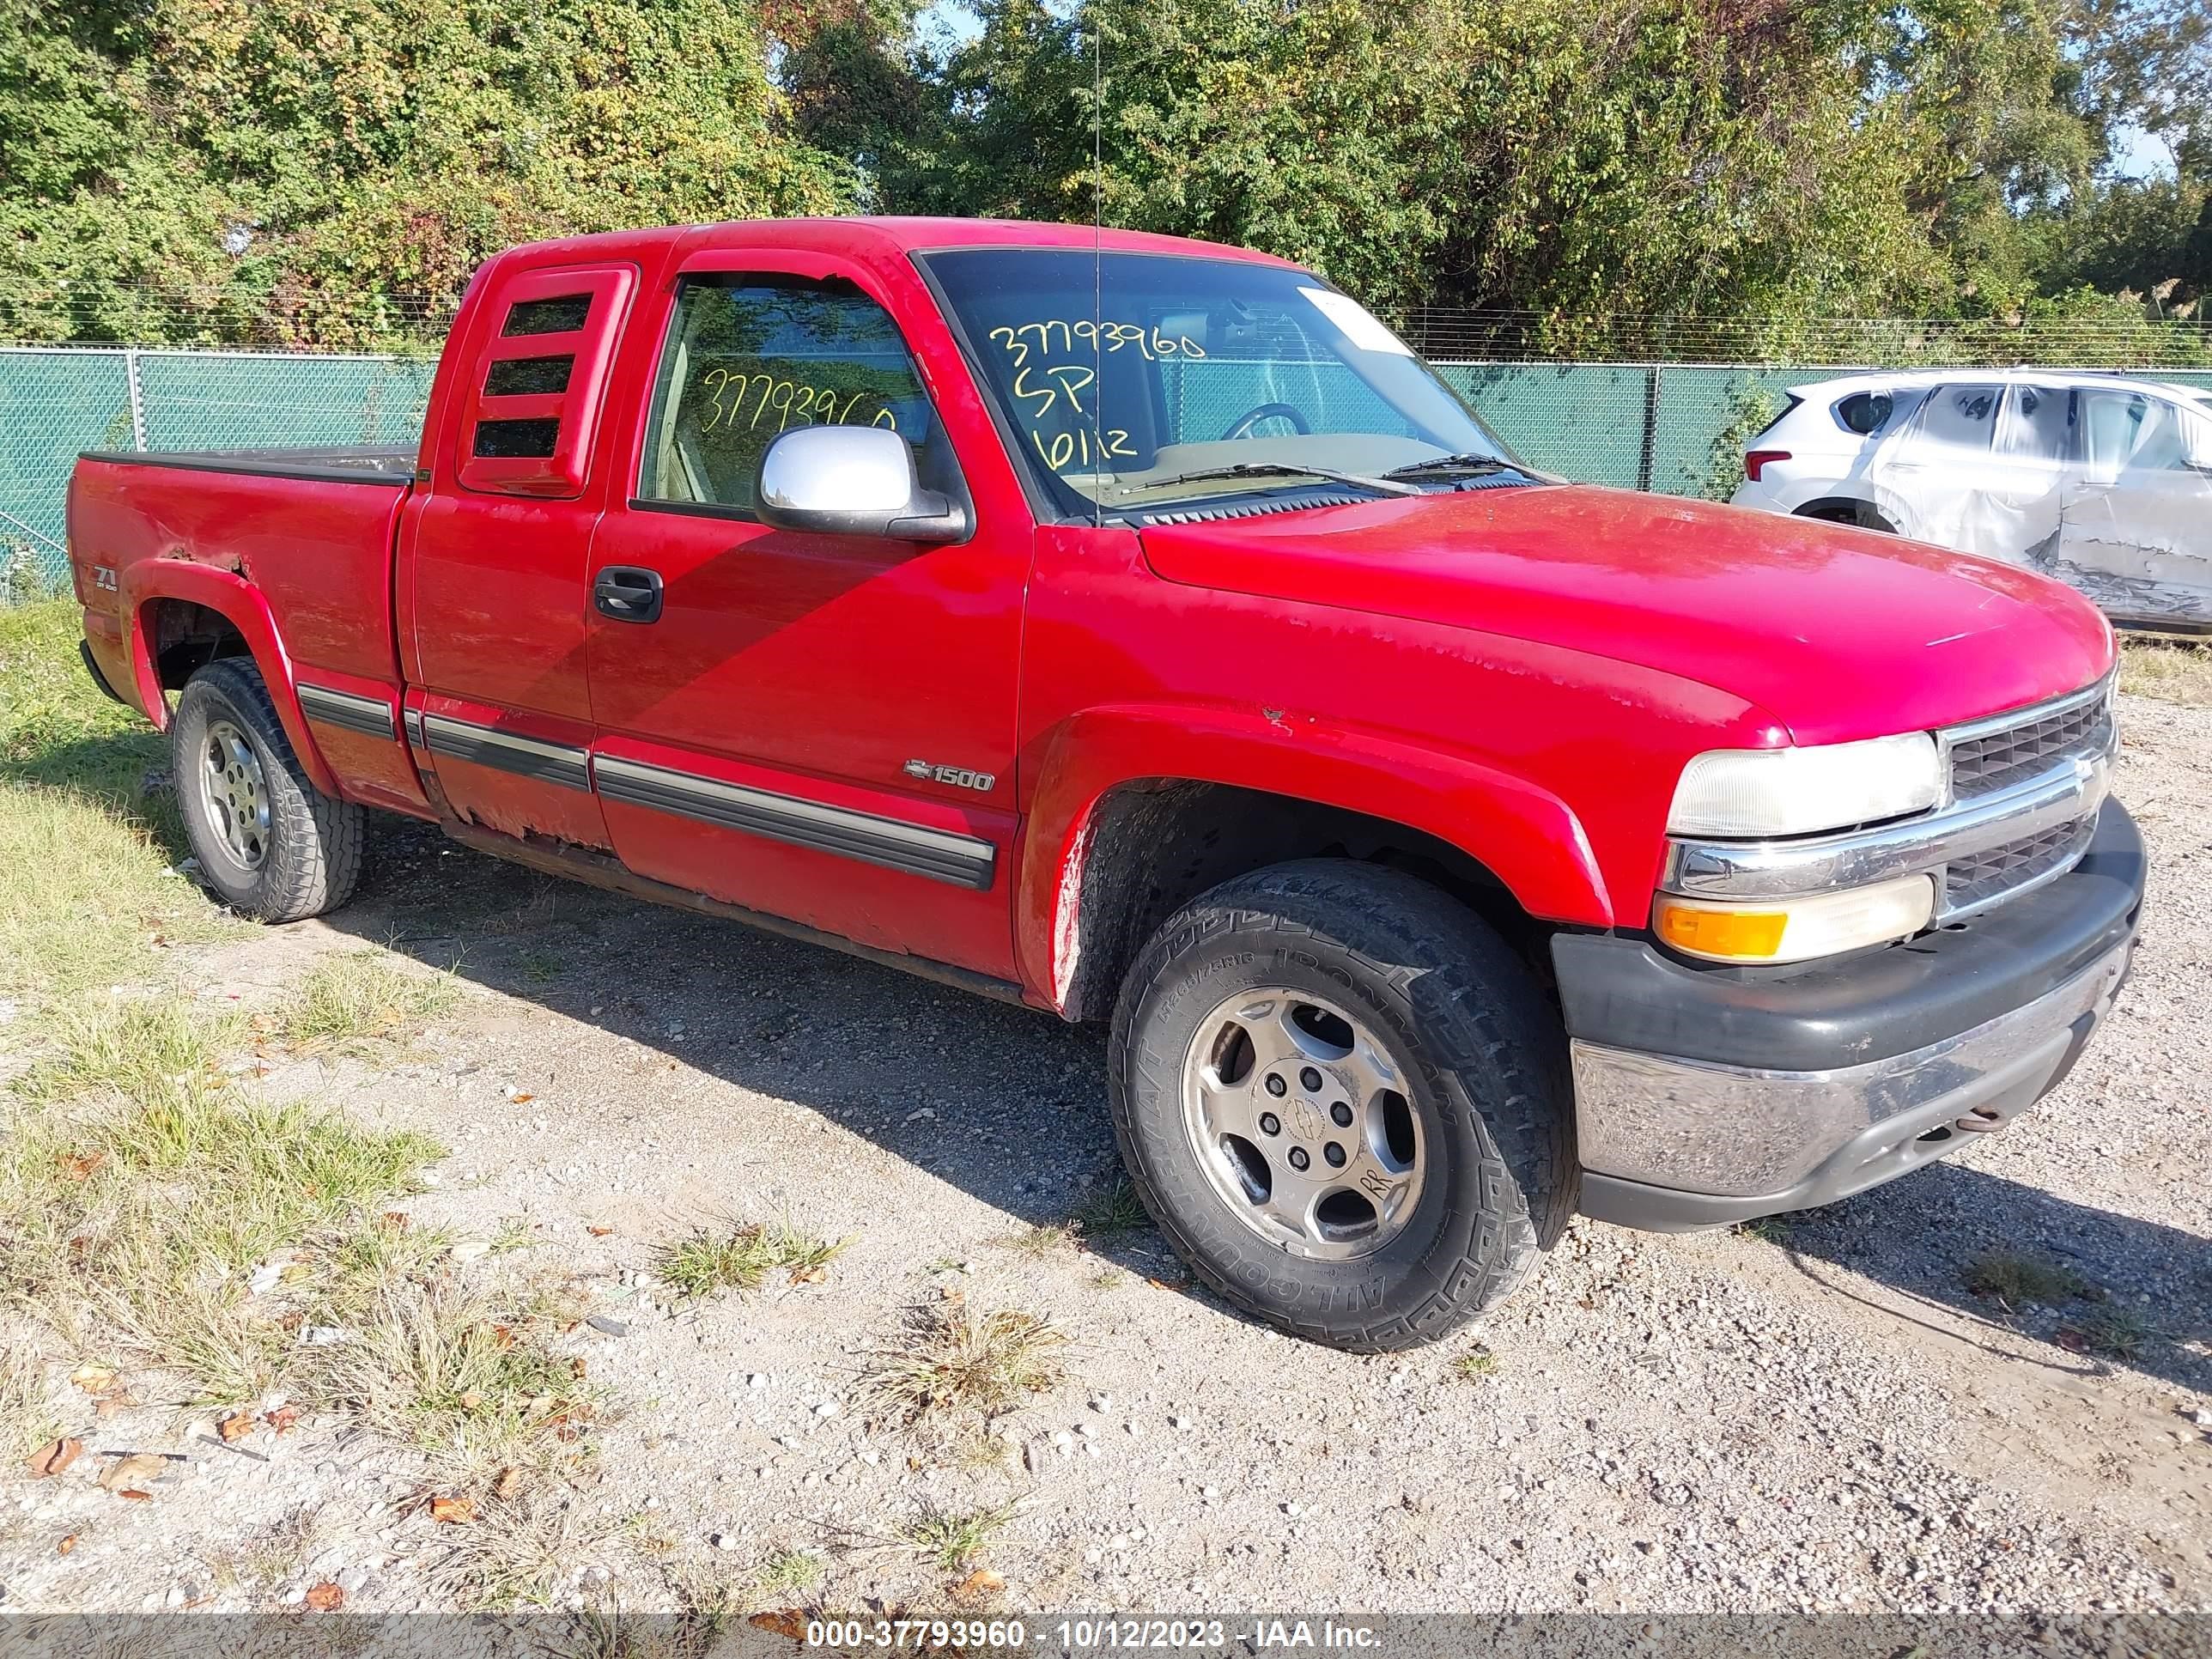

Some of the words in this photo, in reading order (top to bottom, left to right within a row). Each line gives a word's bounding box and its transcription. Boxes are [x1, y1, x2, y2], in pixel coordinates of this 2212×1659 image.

[989, 320, 1206, 368] 37793960
[1014, 366, 1095, 418] SP
[934, 766, 993, 791] 1500
[1359, 1169, 1394, 1201] RR
